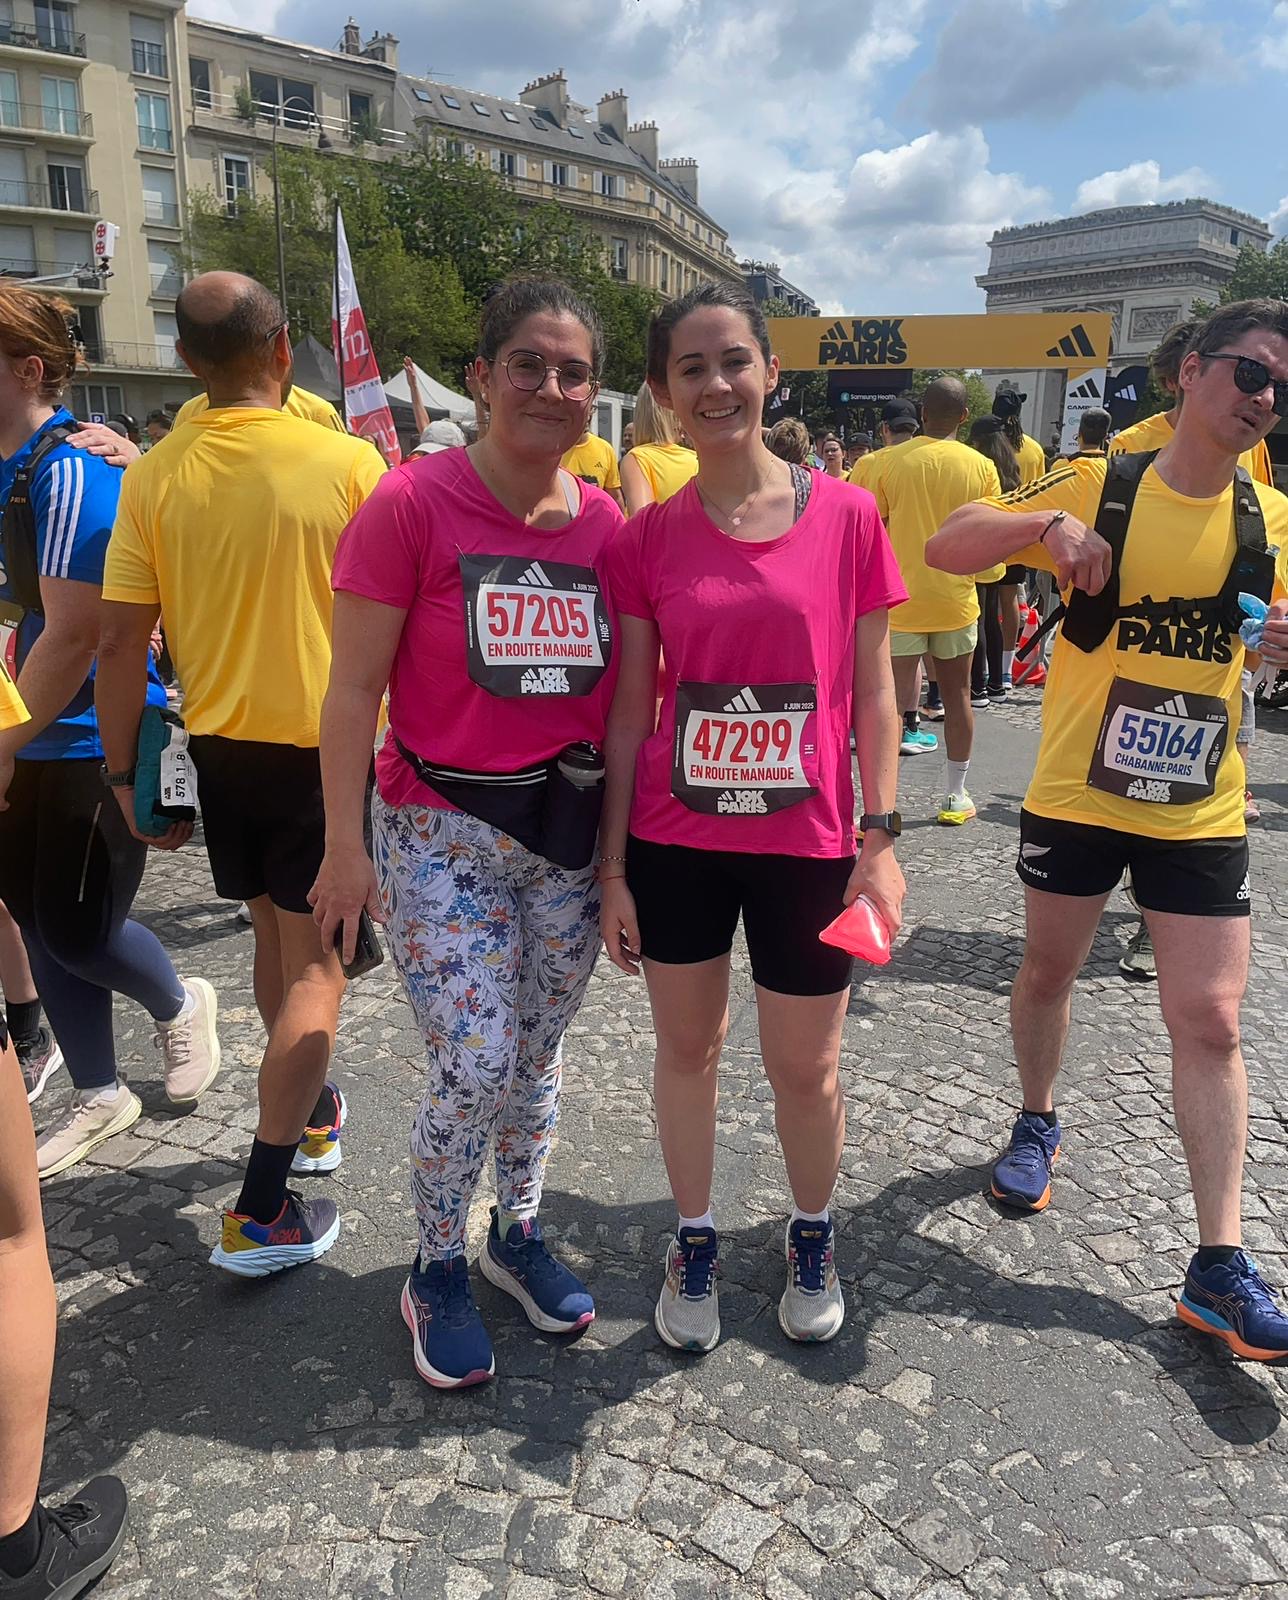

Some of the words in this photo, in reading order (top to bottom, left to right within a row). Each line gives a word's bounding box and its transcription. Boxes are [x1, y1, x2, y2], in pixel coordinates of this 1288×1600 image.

[852, 319, 904, 342] 10K
[819, 341, 907, 365] PARIS
[850, 393, 877, 402] Samsung
[486, 591, 589, 638] 57205
[1116, 619, 1233, 664] PARIS
[488, 643, 503, 657] EN
[505, 643, 542, 657] ROUTE
[543, 643, 593, 658] MANAUDE
[538, 667, 568, 682] 10K
[520, 679, 570, 694] PARIS
[692, 718, 793, 763] 47299
[1118, 713, 1205, 761] 55164
[690, 765, 703, 778] EN
[705, 766, 738, 781] ROUTE
[740, 767, 794, 781] MANAUDE
[1114, 752, 1166, 773] CHABANNE
[1167, 761, 1193, 777] PARIS
[175, 777, 186, 798] 578
[1126, 786, 1171, 802] PARIS
[734, 790, 765, 804] 10K
[718, 801, 768, 814] PARIS
[267, 1228, 302, 1245] HOKA
